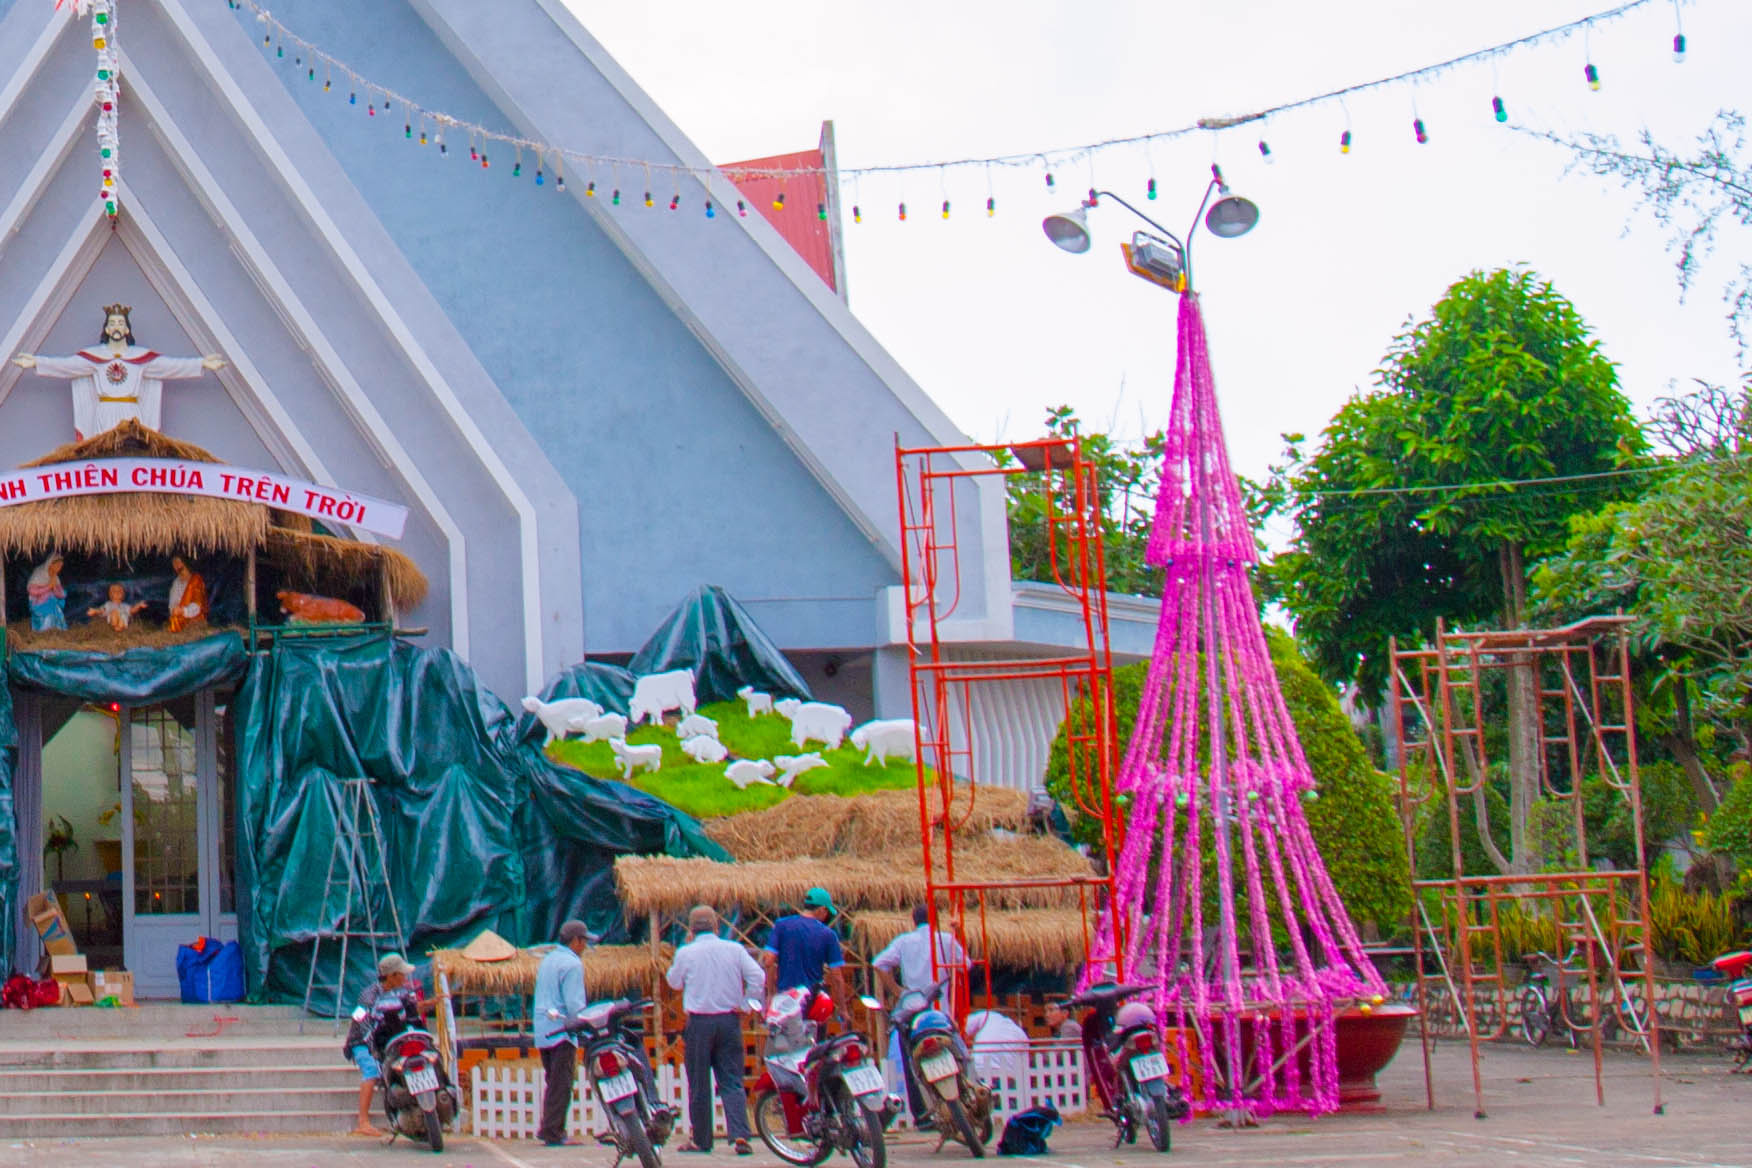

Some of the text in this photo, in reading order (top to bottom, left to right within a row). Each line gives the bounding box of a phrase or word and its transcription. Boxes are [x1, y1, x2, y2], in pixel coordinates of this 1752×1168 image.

[37, 463, 119, 494] THIÊN
[131, 464, 204, 489] CHÚA
[219, 475, 291, 505] TRÊN
[303, 490, 366, 525] TRỜI
